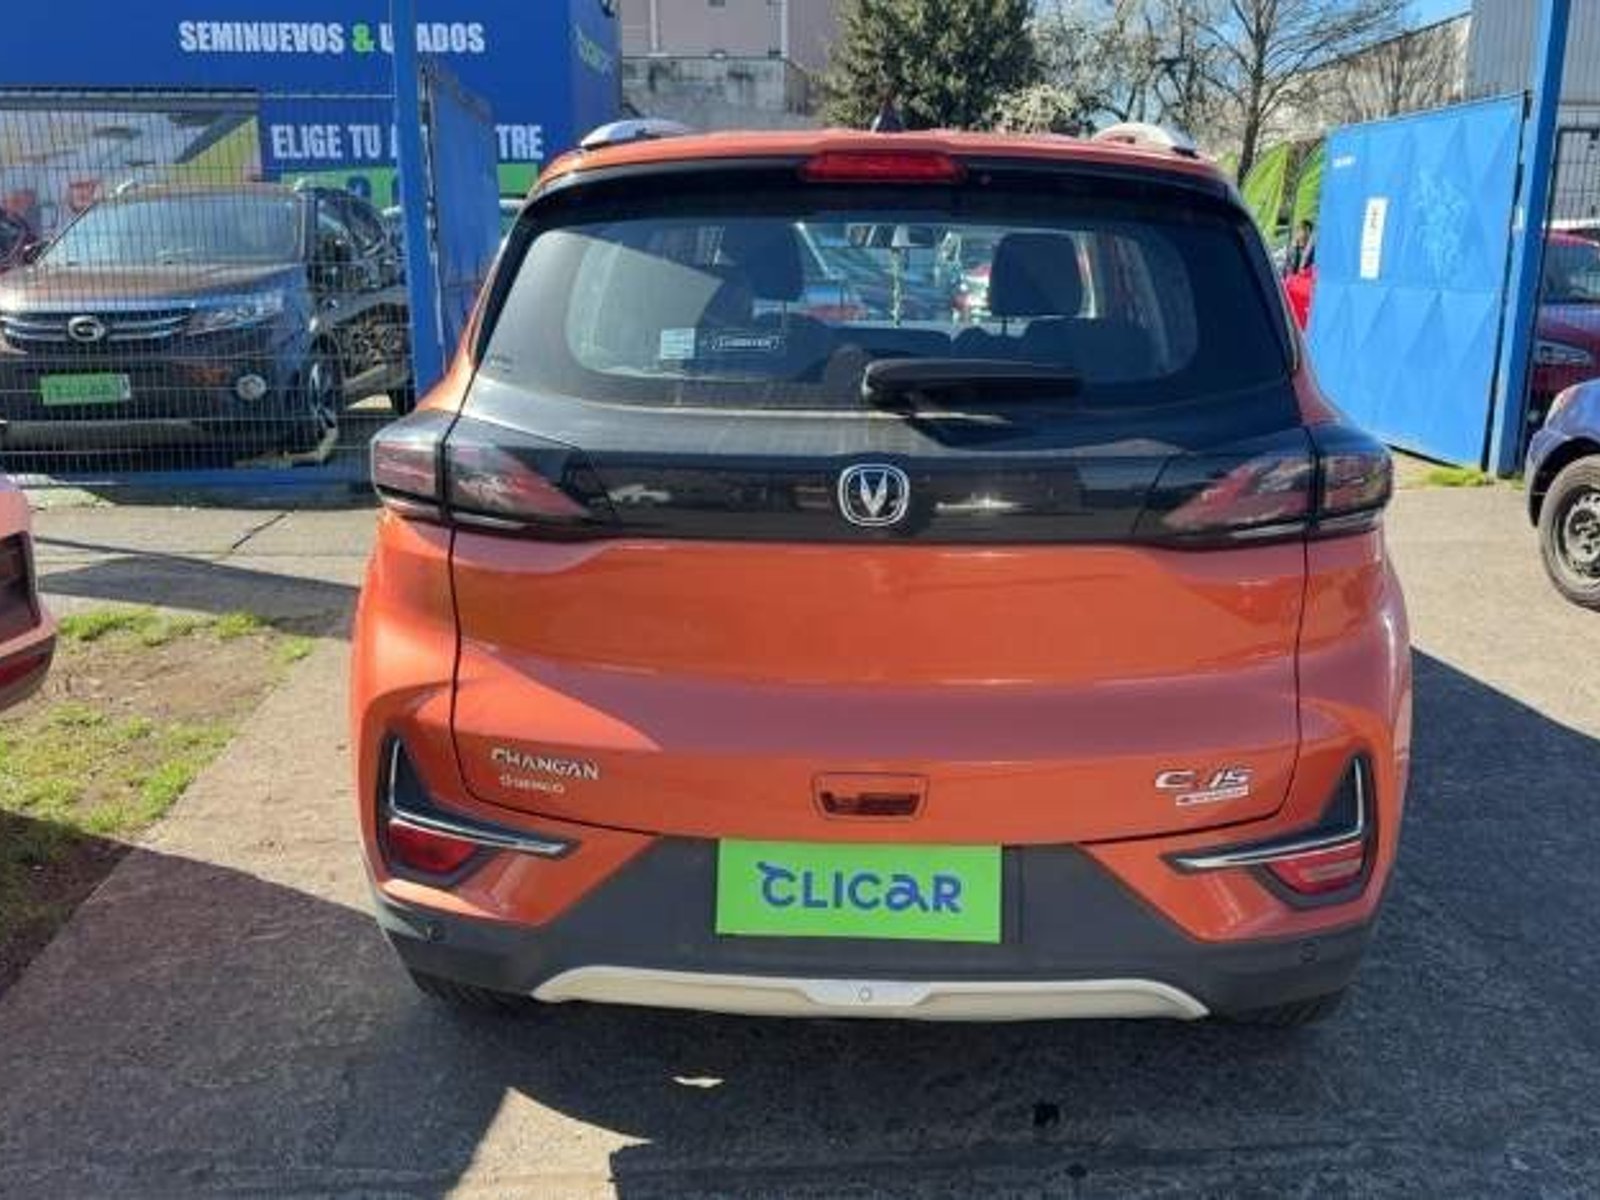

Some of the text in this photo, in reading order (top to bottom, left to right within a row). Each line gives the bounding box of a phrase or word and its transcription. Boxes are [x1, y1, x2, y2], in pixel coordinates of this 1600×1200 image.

[178, 21, 485, 53] SEMINUEVOS & UADOS
[271, 124, 343, 160] ELIGE
[349, 124, 382, 159] TU
[490, 747, 599, 781] CHANGAN
